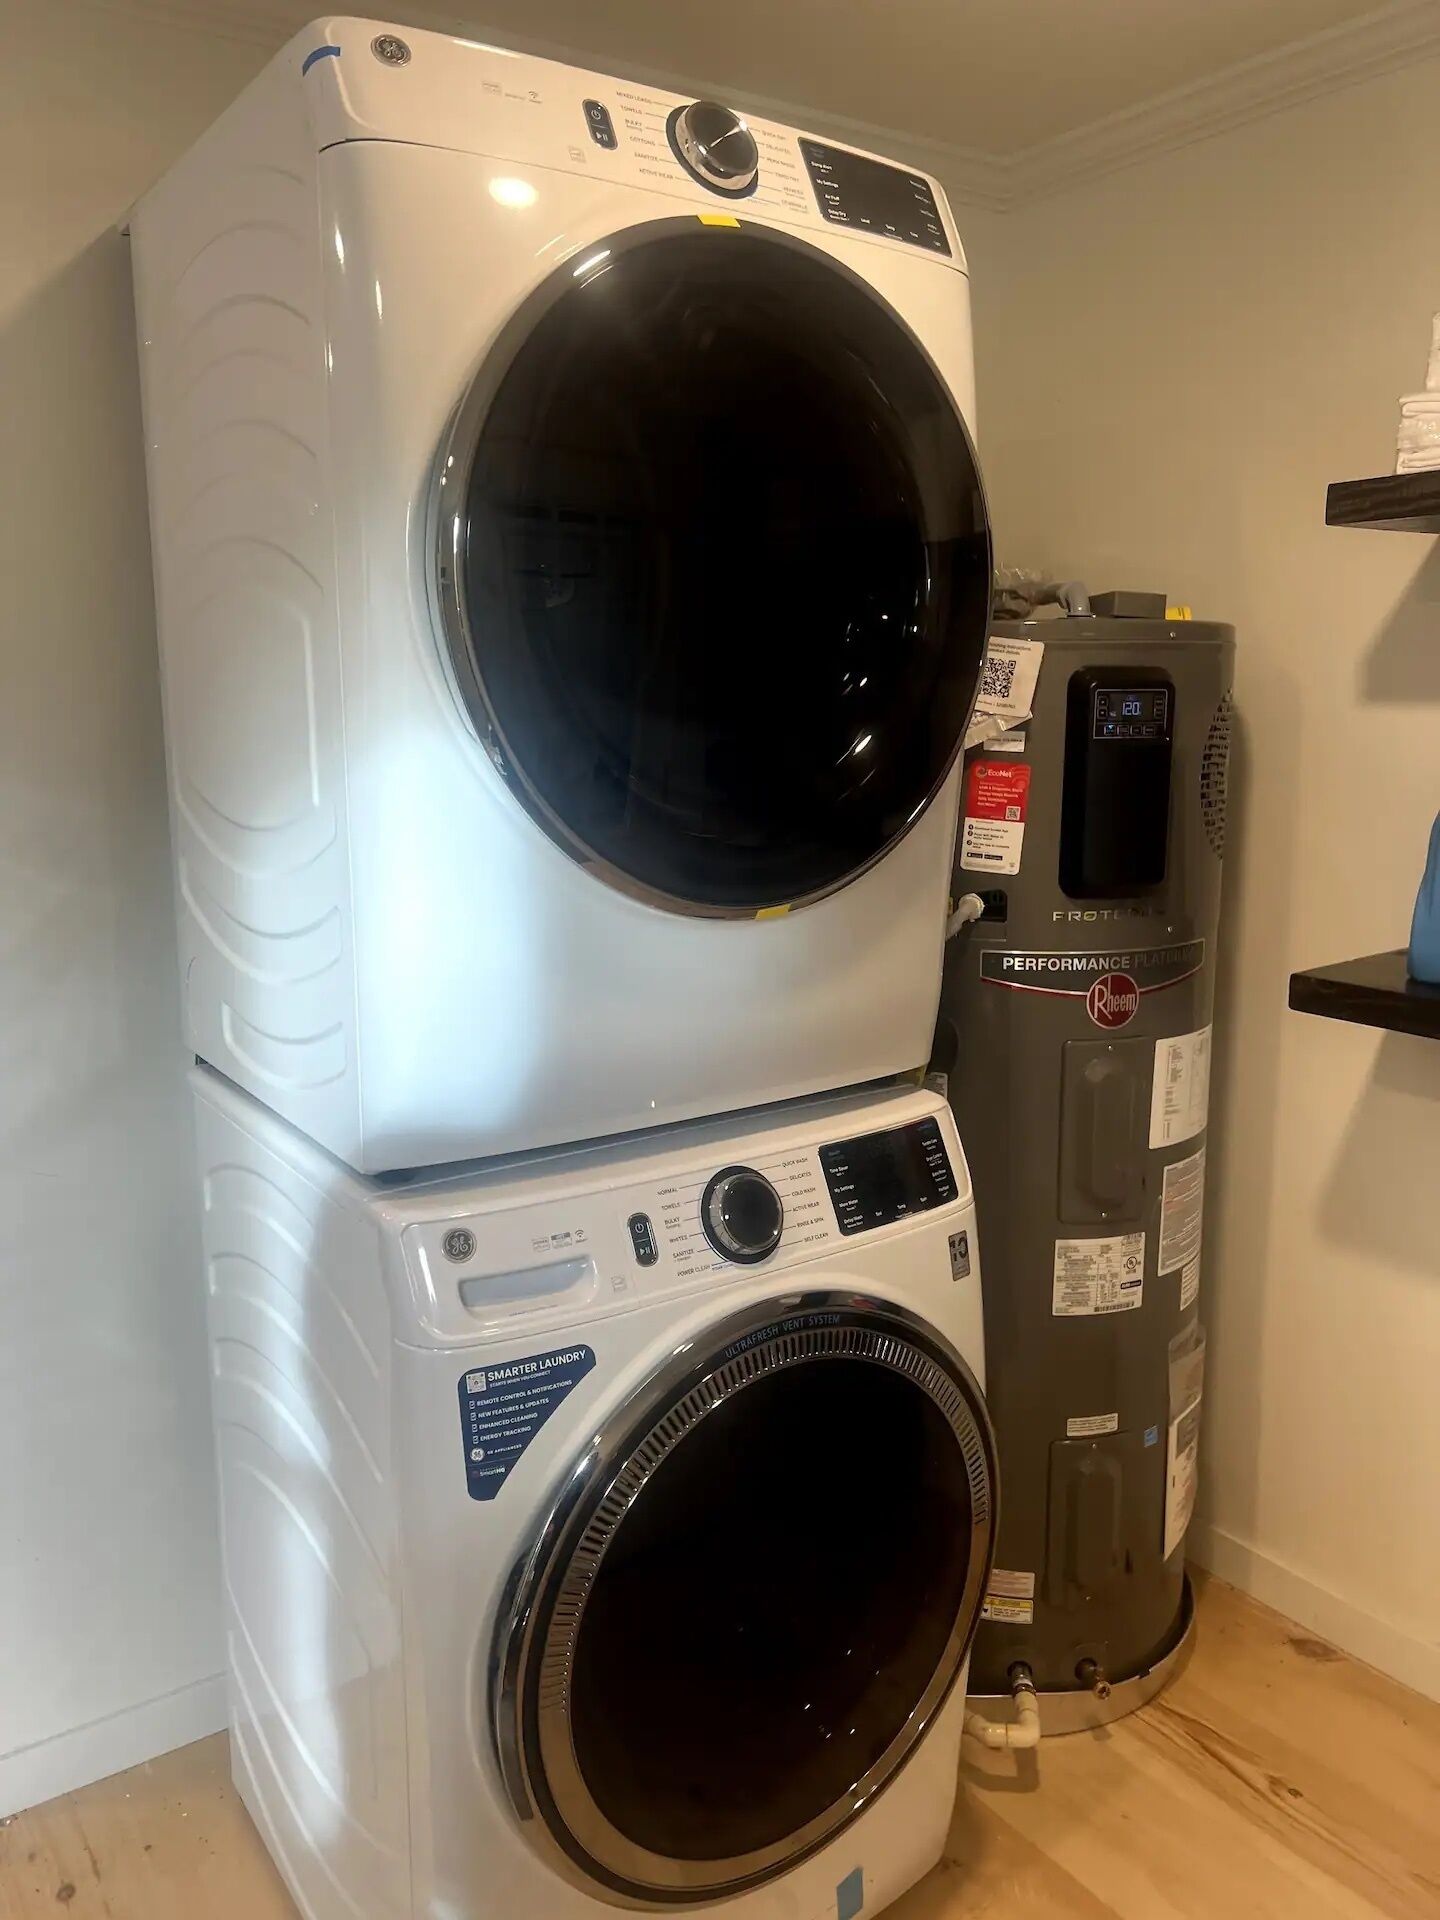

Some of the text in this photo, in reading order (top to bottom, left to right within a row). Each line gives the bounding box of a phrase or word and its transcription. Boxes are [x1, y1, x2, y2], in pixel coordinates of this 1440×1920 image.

[1122, 701, 1140, 716] 120
[987, 768, 1012, 778] EcoNet
[1002, 955, 1130, 972] PERFORMANCE
[1093, 975, 1137, 1021] Rheem
[789, 1171, 812, 1181] DELICATES
[657, 1187, 678, 1196] NORMAL
[791, 1189, 804, 1197] COLD
[661, 1202, 681, 1211] TOWELS
[792, 1204, 807, 1212] ACTIVE
[664, 1217, 680, 1226] BULKY
[669, 1234, 688, 1244] WHITES
[814, 1232, 829, 1240] CLEAN
[672, 1248, 694, 1259] SANITIZE
[677, 1267, 695, 1277] POWER
[694, 1264, 711, 1274] CLEAN
[724, 1314, 840, 1359] ULTRAFRESH VENT SYSTEM
[487, 1349, 586, 1382] SMARTER LAUNDRY
[476, 1397, 499, 1407] REMOTE
[499, 1390, 527, 1402] CONTROL
[532, 1379, 573, 1394] NOTIFICATIONS
[477, 1410, 491, 1419] NEW
[491, 1404, 519, 1417] FEATURES
[524, 1397, 550, 1409] UPDATES
[478, 1412, 538, 1430] ENHANCED CLEANING
[480, 1425, 532, 1442] ENERGY TRACKING
